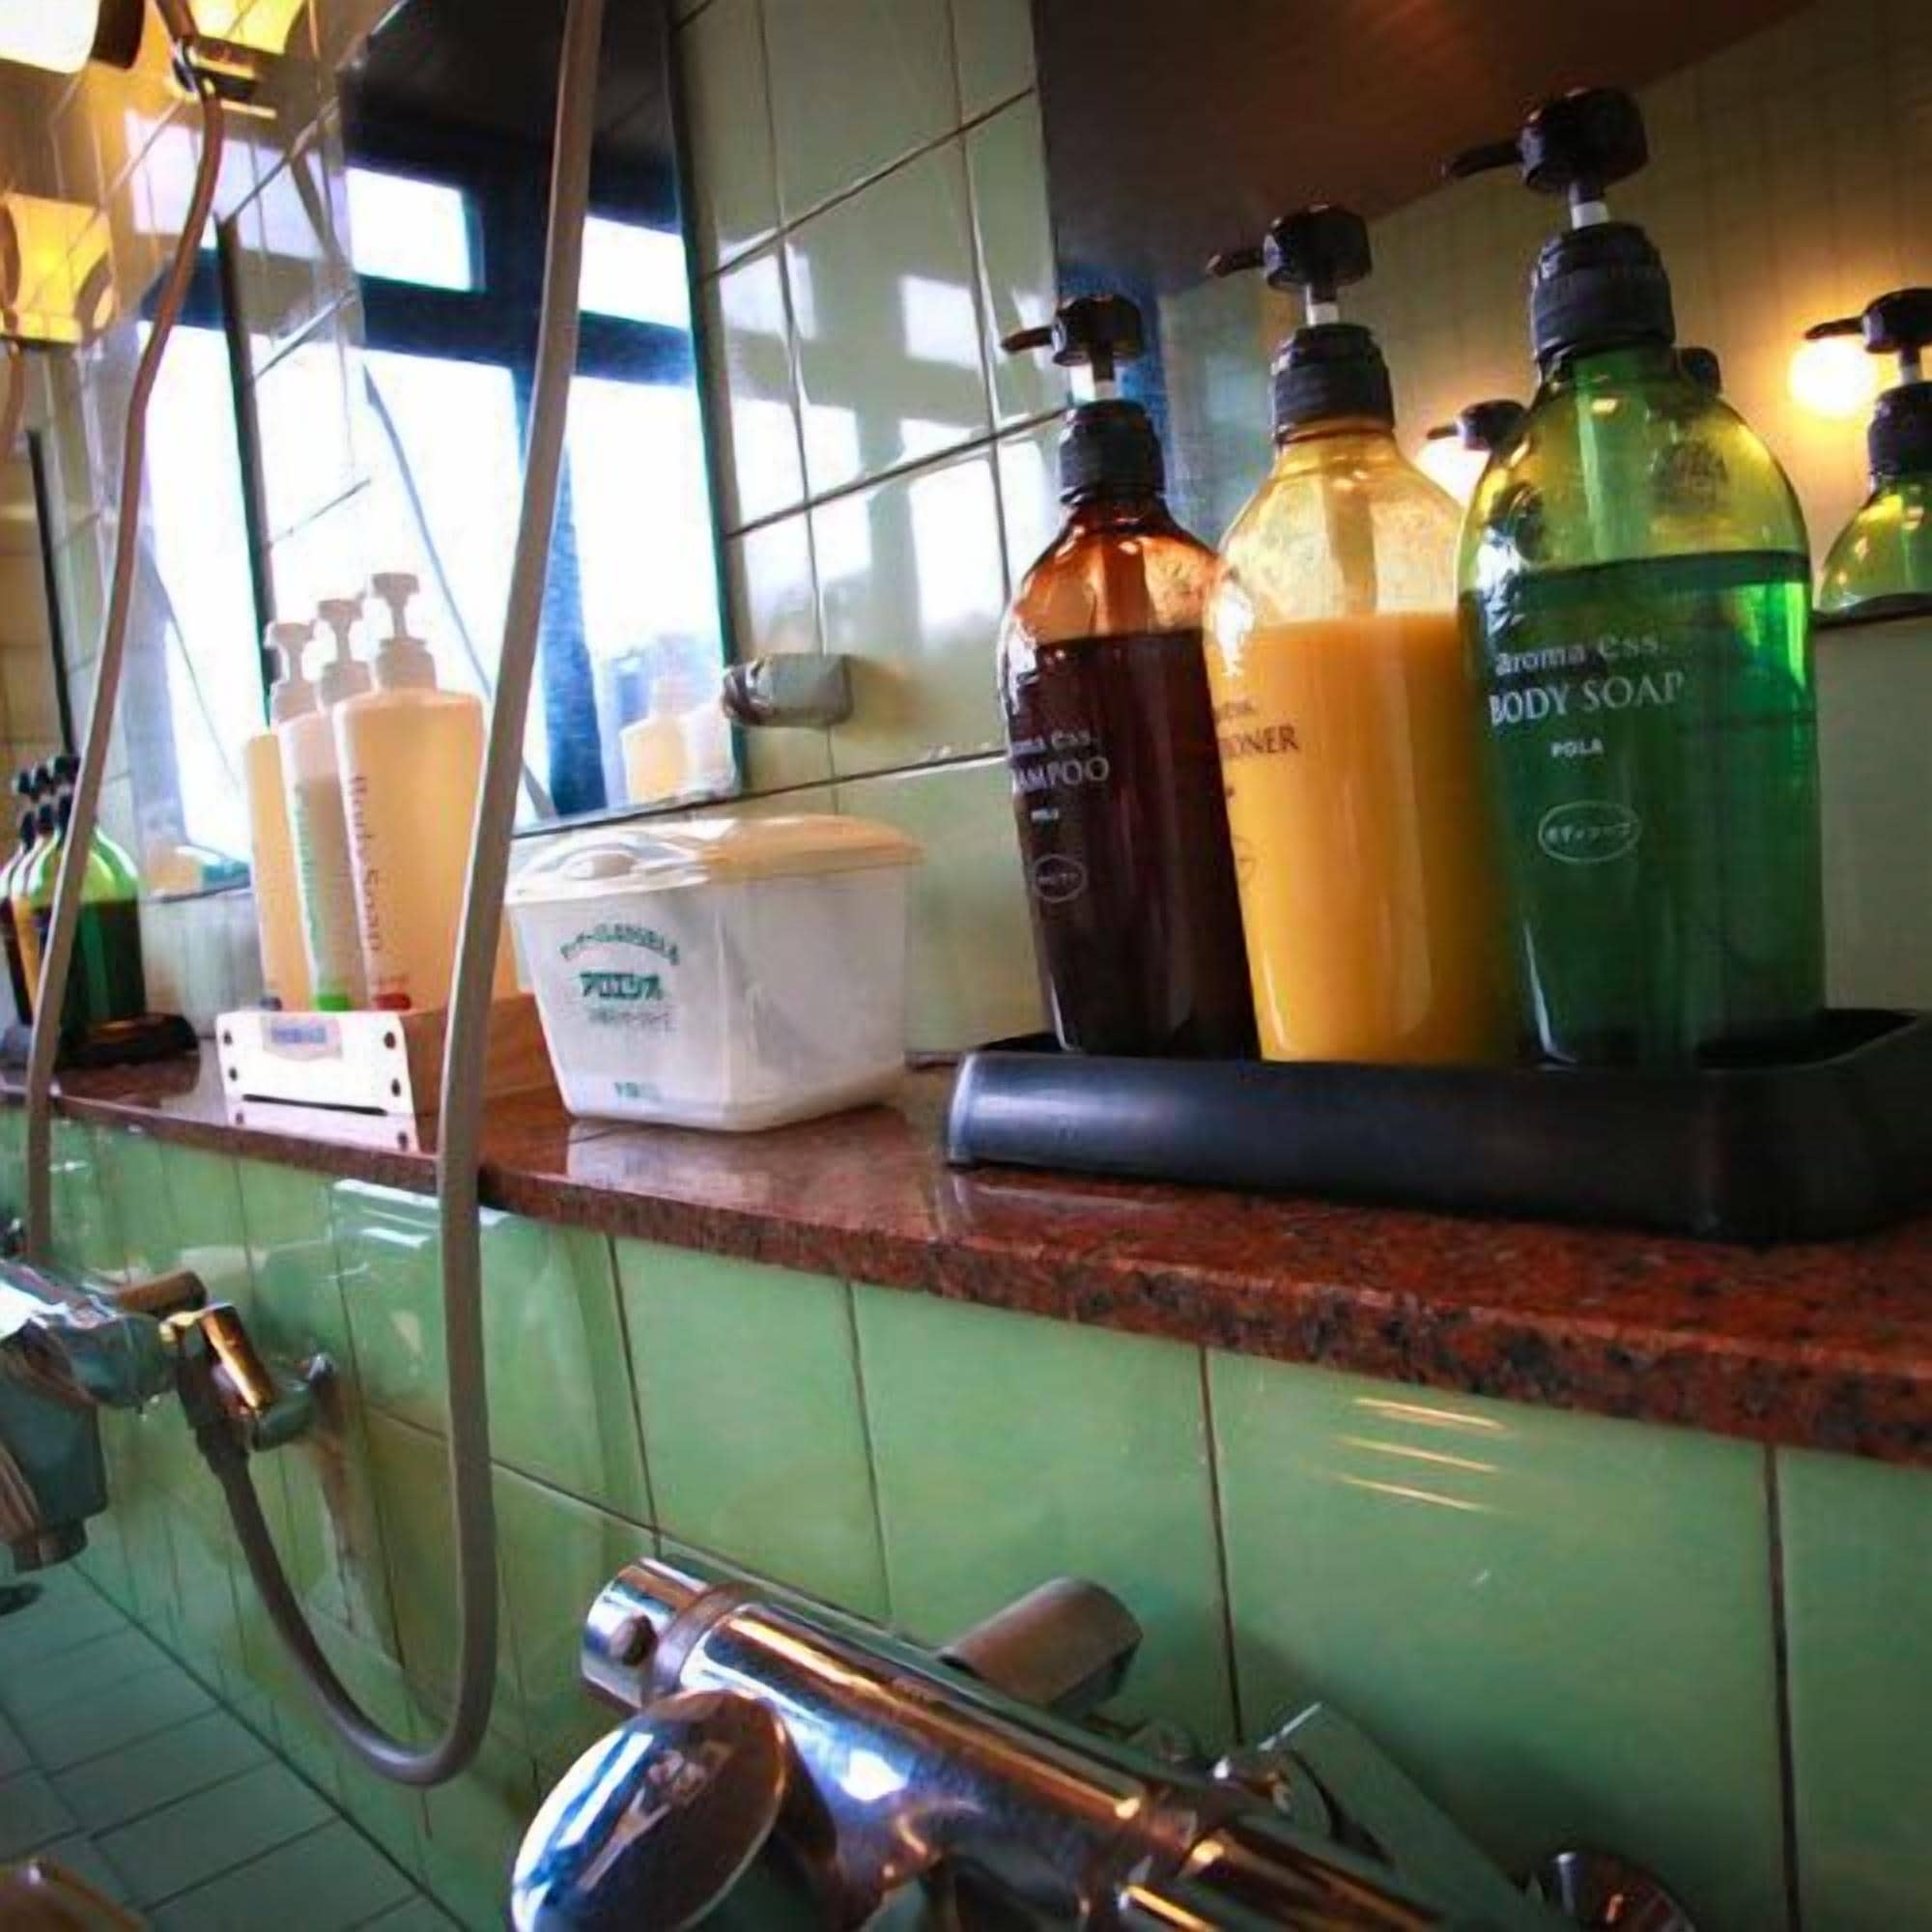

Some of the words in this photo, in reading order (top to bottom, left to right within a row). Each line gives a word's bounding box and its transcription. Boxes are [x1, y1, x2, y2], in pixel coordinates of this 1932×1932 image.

[1489, 687, 1570, 726] BODY
[1582, 671, 1685, 712] SOAP
[1550, 739, 1604, 758] POLA
